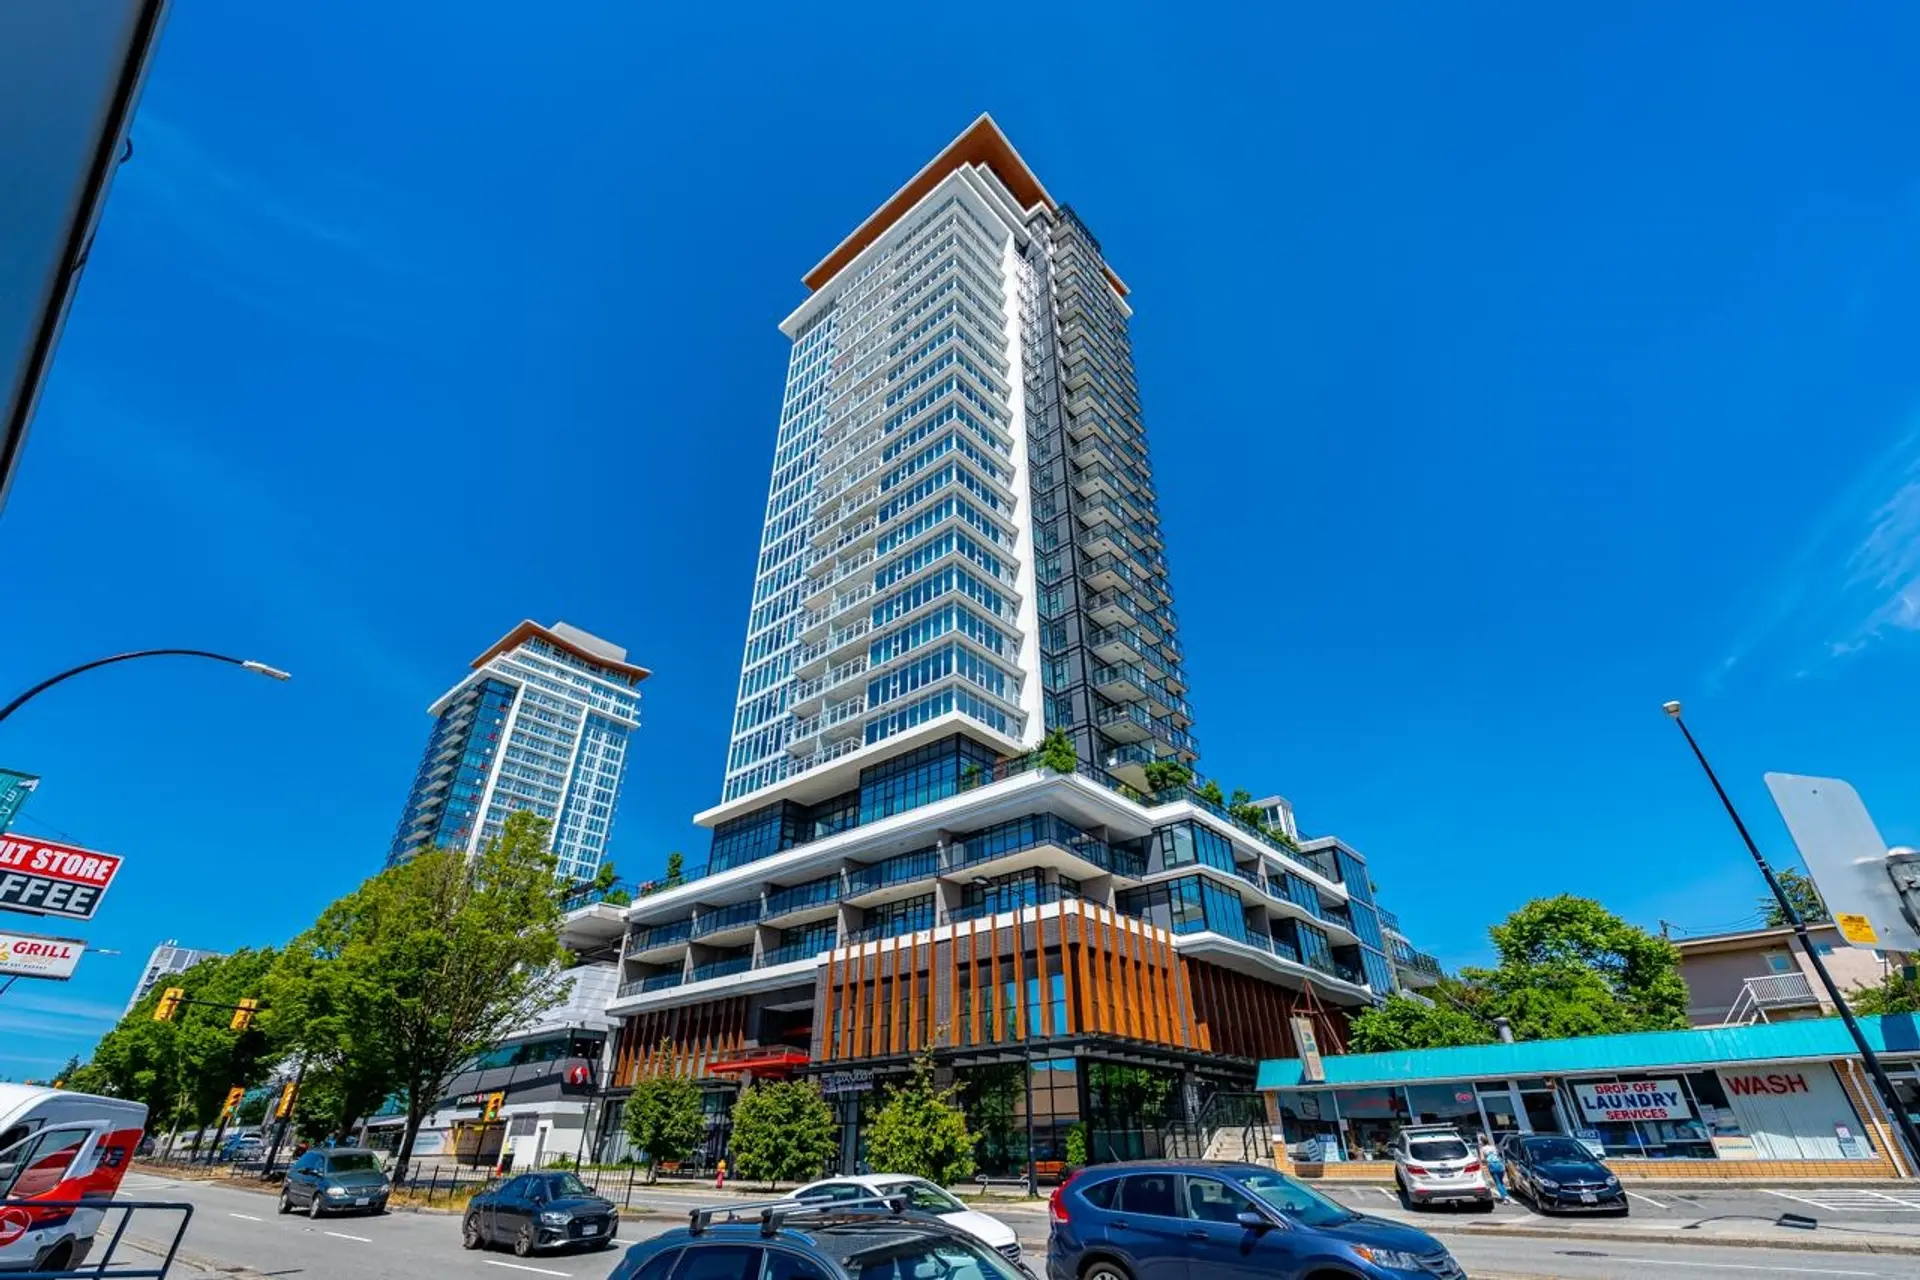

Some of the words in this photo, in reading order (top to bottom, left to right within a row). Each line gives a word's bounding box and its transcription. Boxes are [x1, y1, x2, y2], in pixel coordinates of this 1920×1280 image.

[30, 848, 113, 880] STORE
[13, 941, 71, 959] GRILL
[1594, 1084, 1629, 1094] DROP
[1632, 1082, 1657, 1092] OFF
[1725, 1074, 1809, 1095] WASH
[1583, 1092, 1678, 1109] LAUNDRY
[1606, 1108, 1668, 1120] SERVICES
